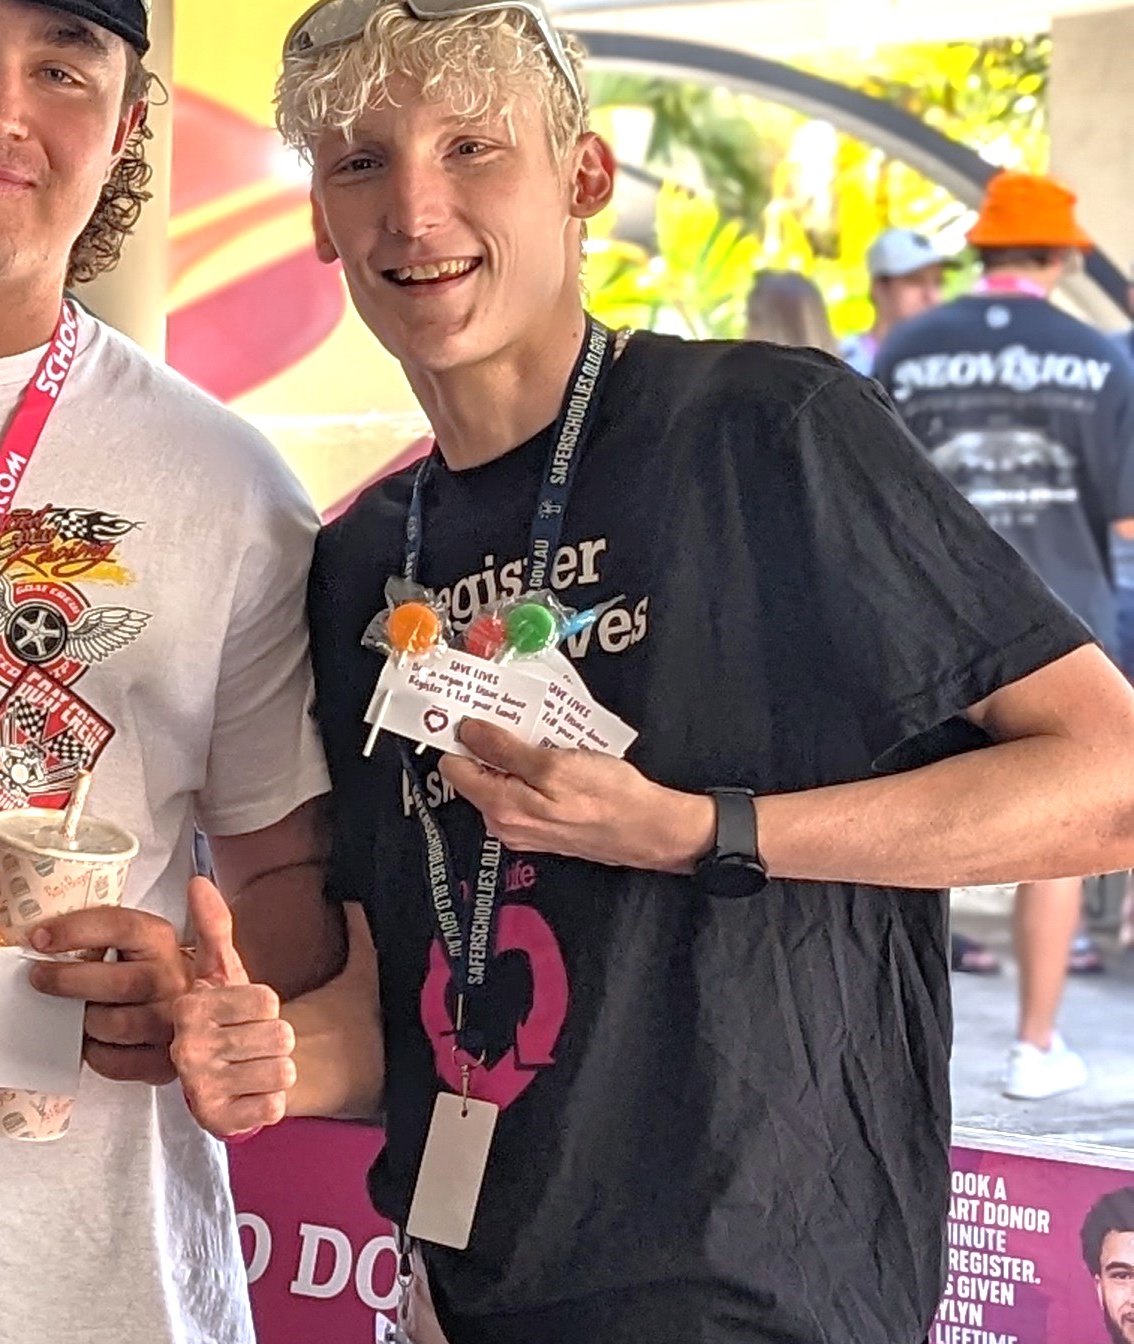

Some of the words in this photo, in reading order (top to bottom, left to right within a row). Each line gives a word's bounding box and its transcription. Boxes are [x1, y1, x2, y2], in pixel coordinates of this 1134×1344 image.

[449, 659, 472, 677] SAVE
[473, 667, 501, 686] LIVES
[950, 1170, 991, 1198] OOK
[993, 1176, 1008, 1201] A
[982, 1202, 1050, 1234] DONOR
[948, 1248, 1042, 1285] REGISTER.
[956, 1276, 1015, 1307] GIVEN
